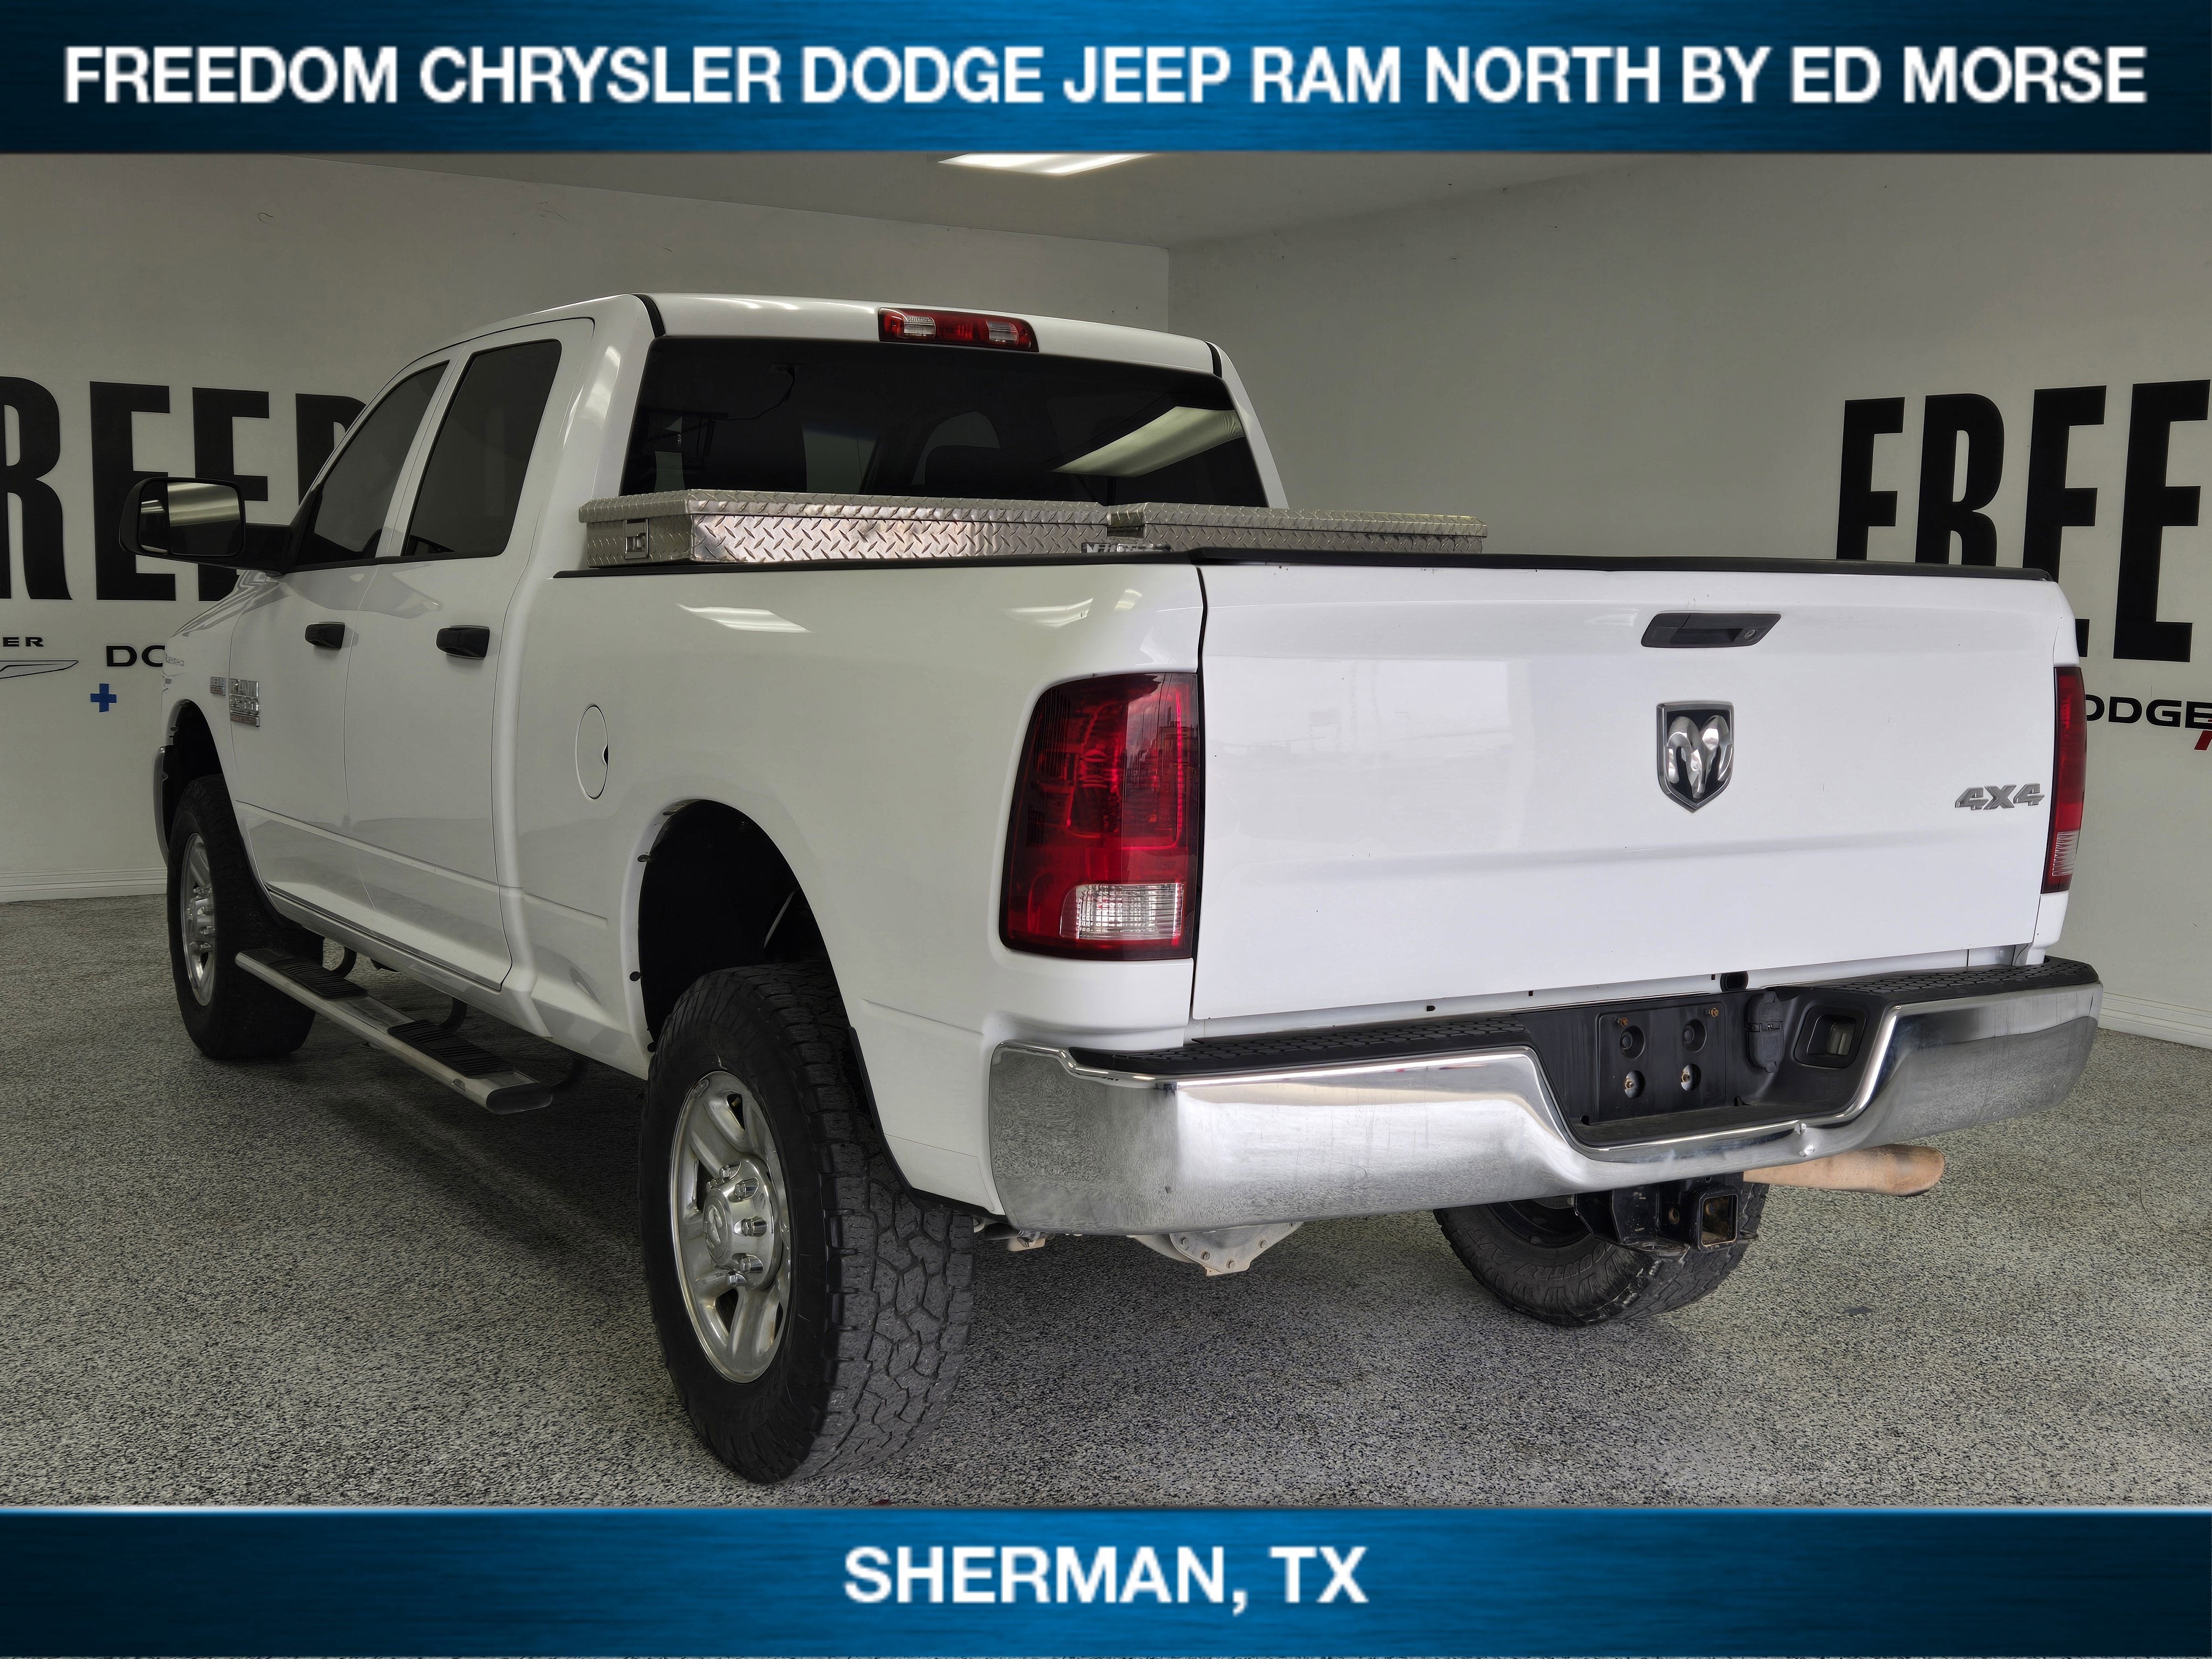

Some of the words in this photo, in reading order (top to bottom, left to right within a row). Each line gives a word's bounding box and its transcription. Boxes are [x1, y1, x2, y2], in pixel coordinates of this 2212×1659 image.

[0, 376, 367, 601] REE
[1835, 379, 2211, 662] FREE
[2, 637, 44, 648] ER
[1515, 1242, 1613, 1281] OUNTRY
